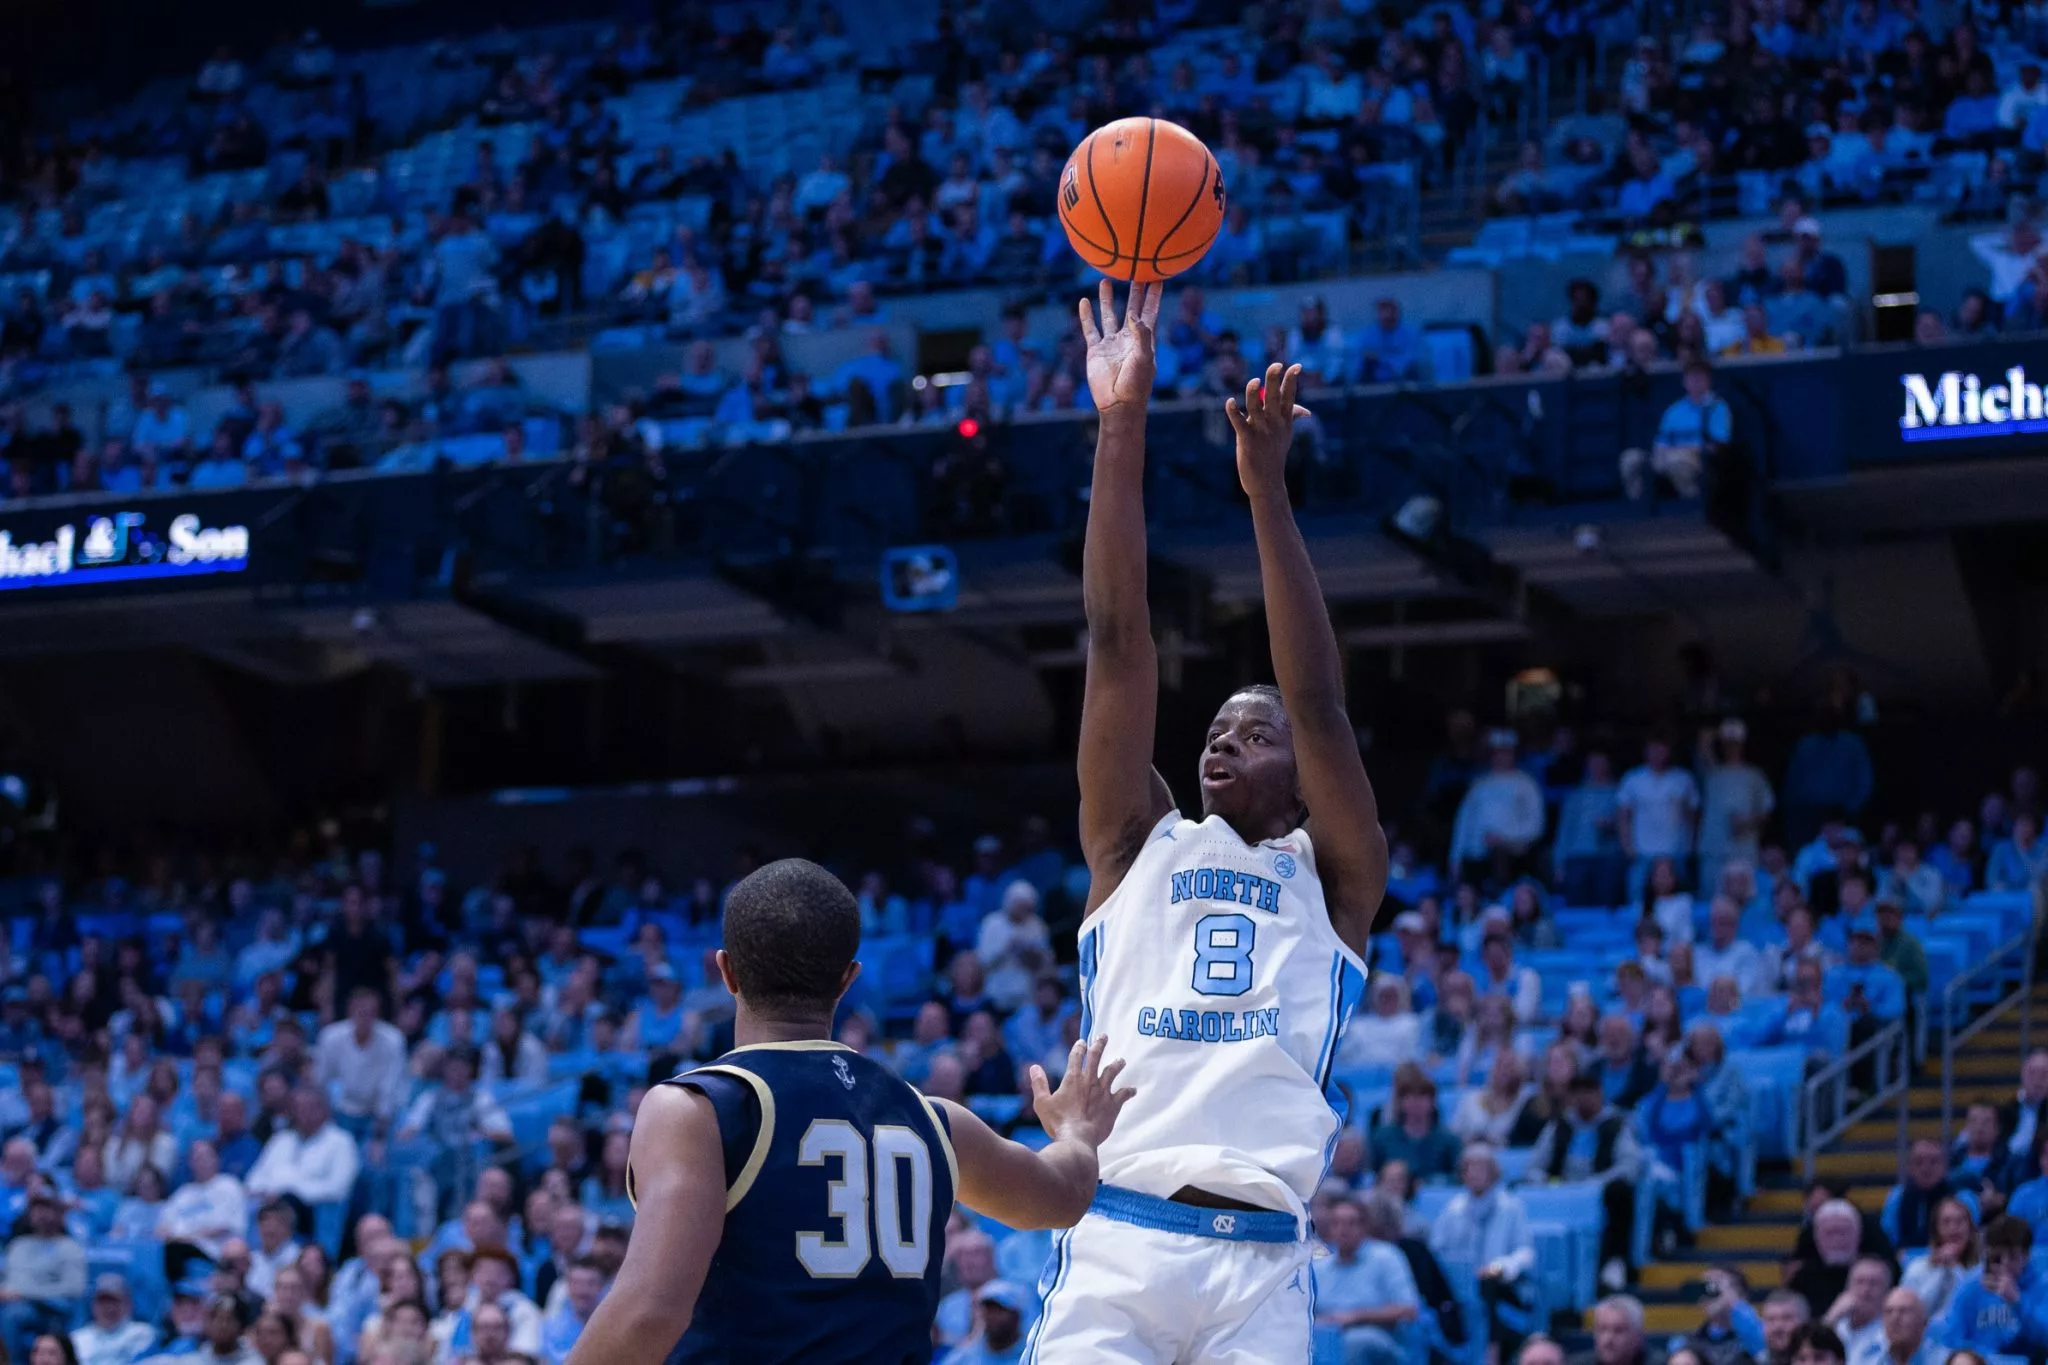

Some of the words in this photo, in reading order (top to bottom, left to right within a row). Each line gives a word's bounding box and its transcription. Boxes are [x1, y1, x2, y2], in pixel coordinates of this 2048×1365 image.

[1899, 366, 2048, 428] Mich
[167, 513, 249, 566] Son
[1171, 868, 1281, 914] NORTH
[1191, 913, 1256, 997] 8
[1137, 1006, 1280, 1043] CAROLIN
[795, 1118, 933, 1279] 30
